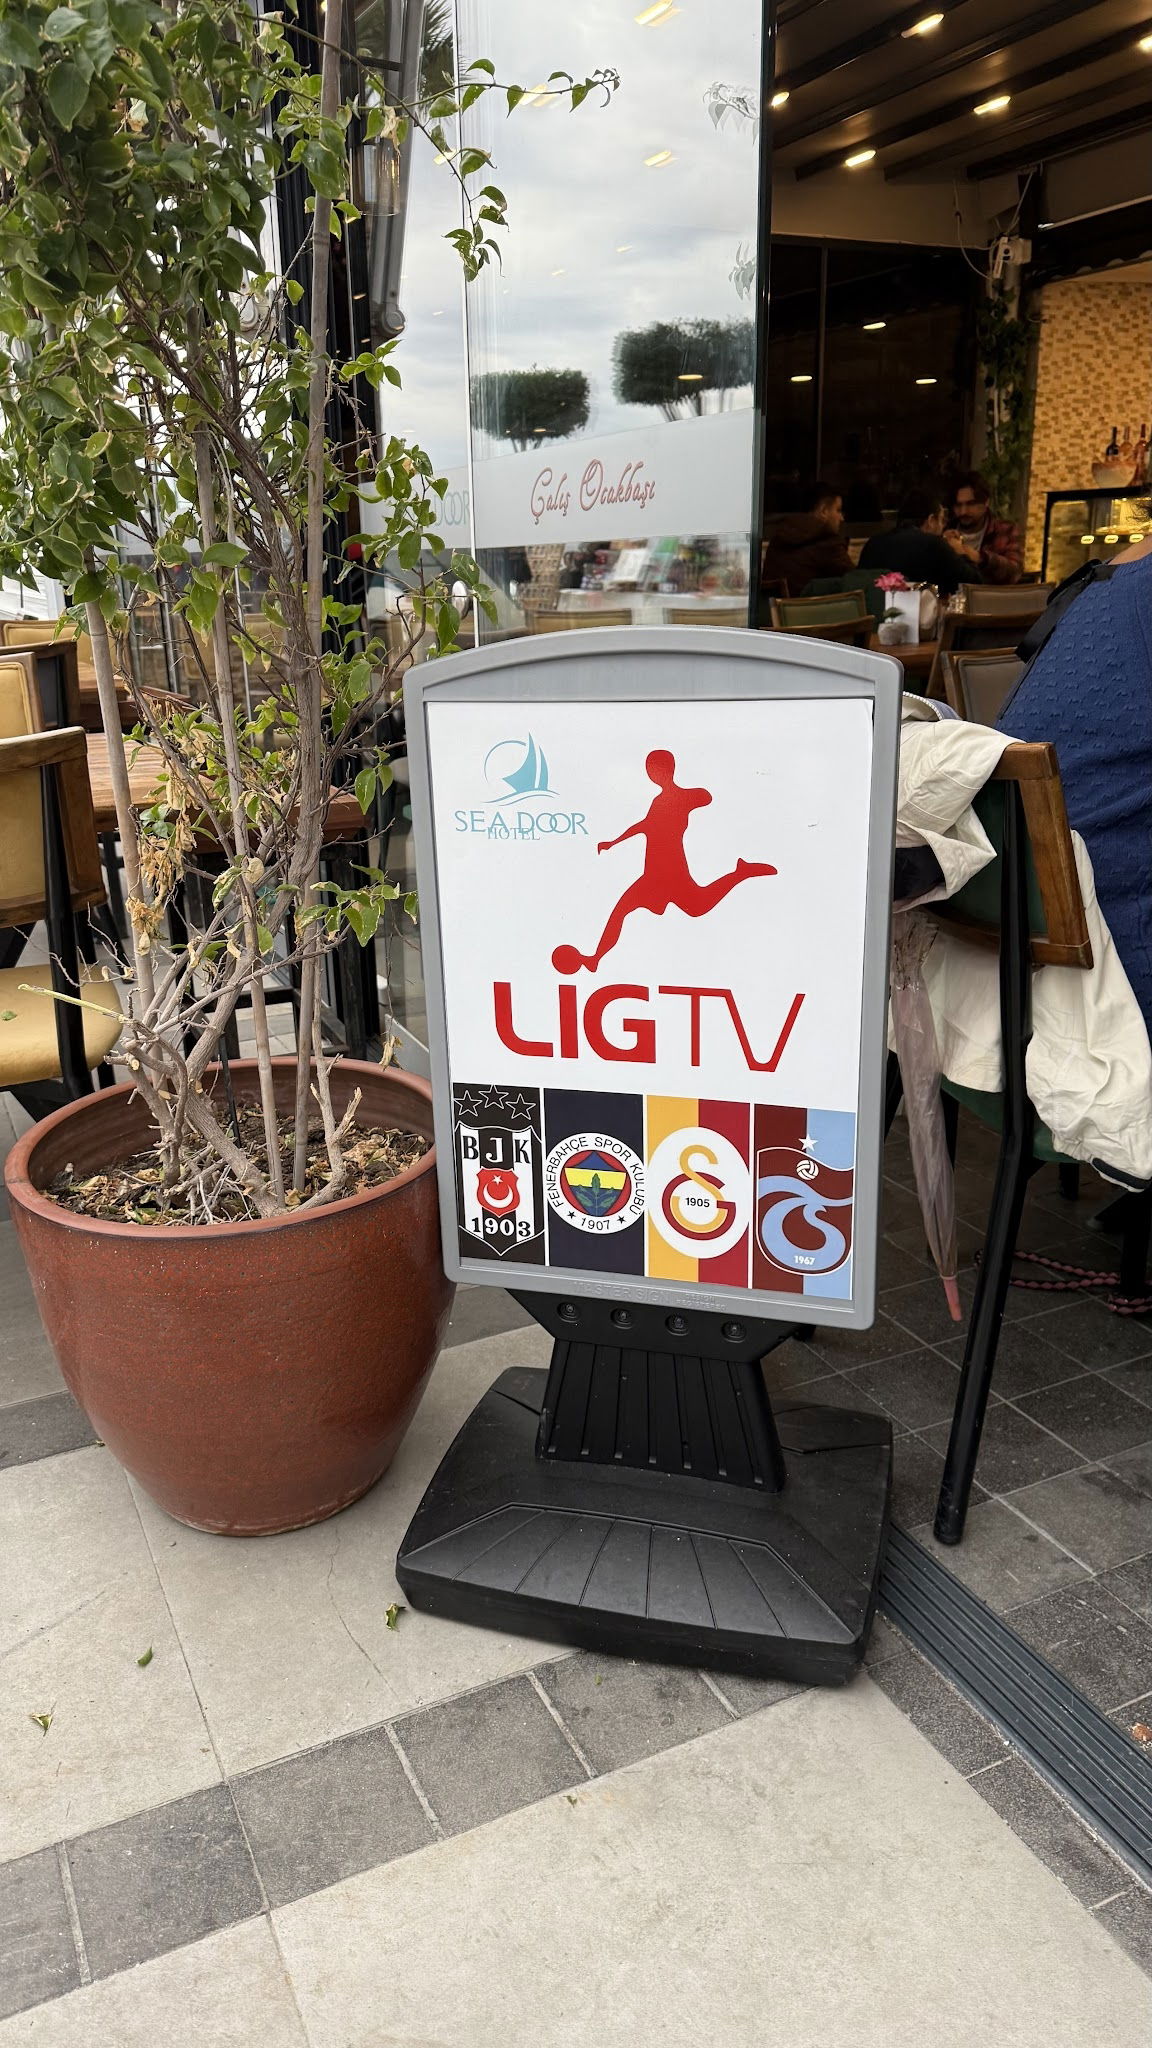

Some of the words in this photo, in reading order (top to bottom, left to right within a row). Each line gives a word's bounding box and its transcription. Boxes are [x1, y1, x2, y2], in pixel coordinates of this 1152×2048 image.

[530, 466, 571, 525] Çalış
[579, 458, 656, 511] Ocakbaşı
[454, 810, 508, 833] SEA
[517, 811, 589, 835] DOOR
[487, 826, 541, 841] HOTEL
[546, 1136, 589, 1208] FENERBAHÇE
[594, 1136, 632, 1162] SPOR
[686, 1197, 710, 1208] 1905
[471, 1217, 532, 1237] 1903
[581, 1217, 611, 1231] 1907
[794, 1255, 816, 1266] 1967
